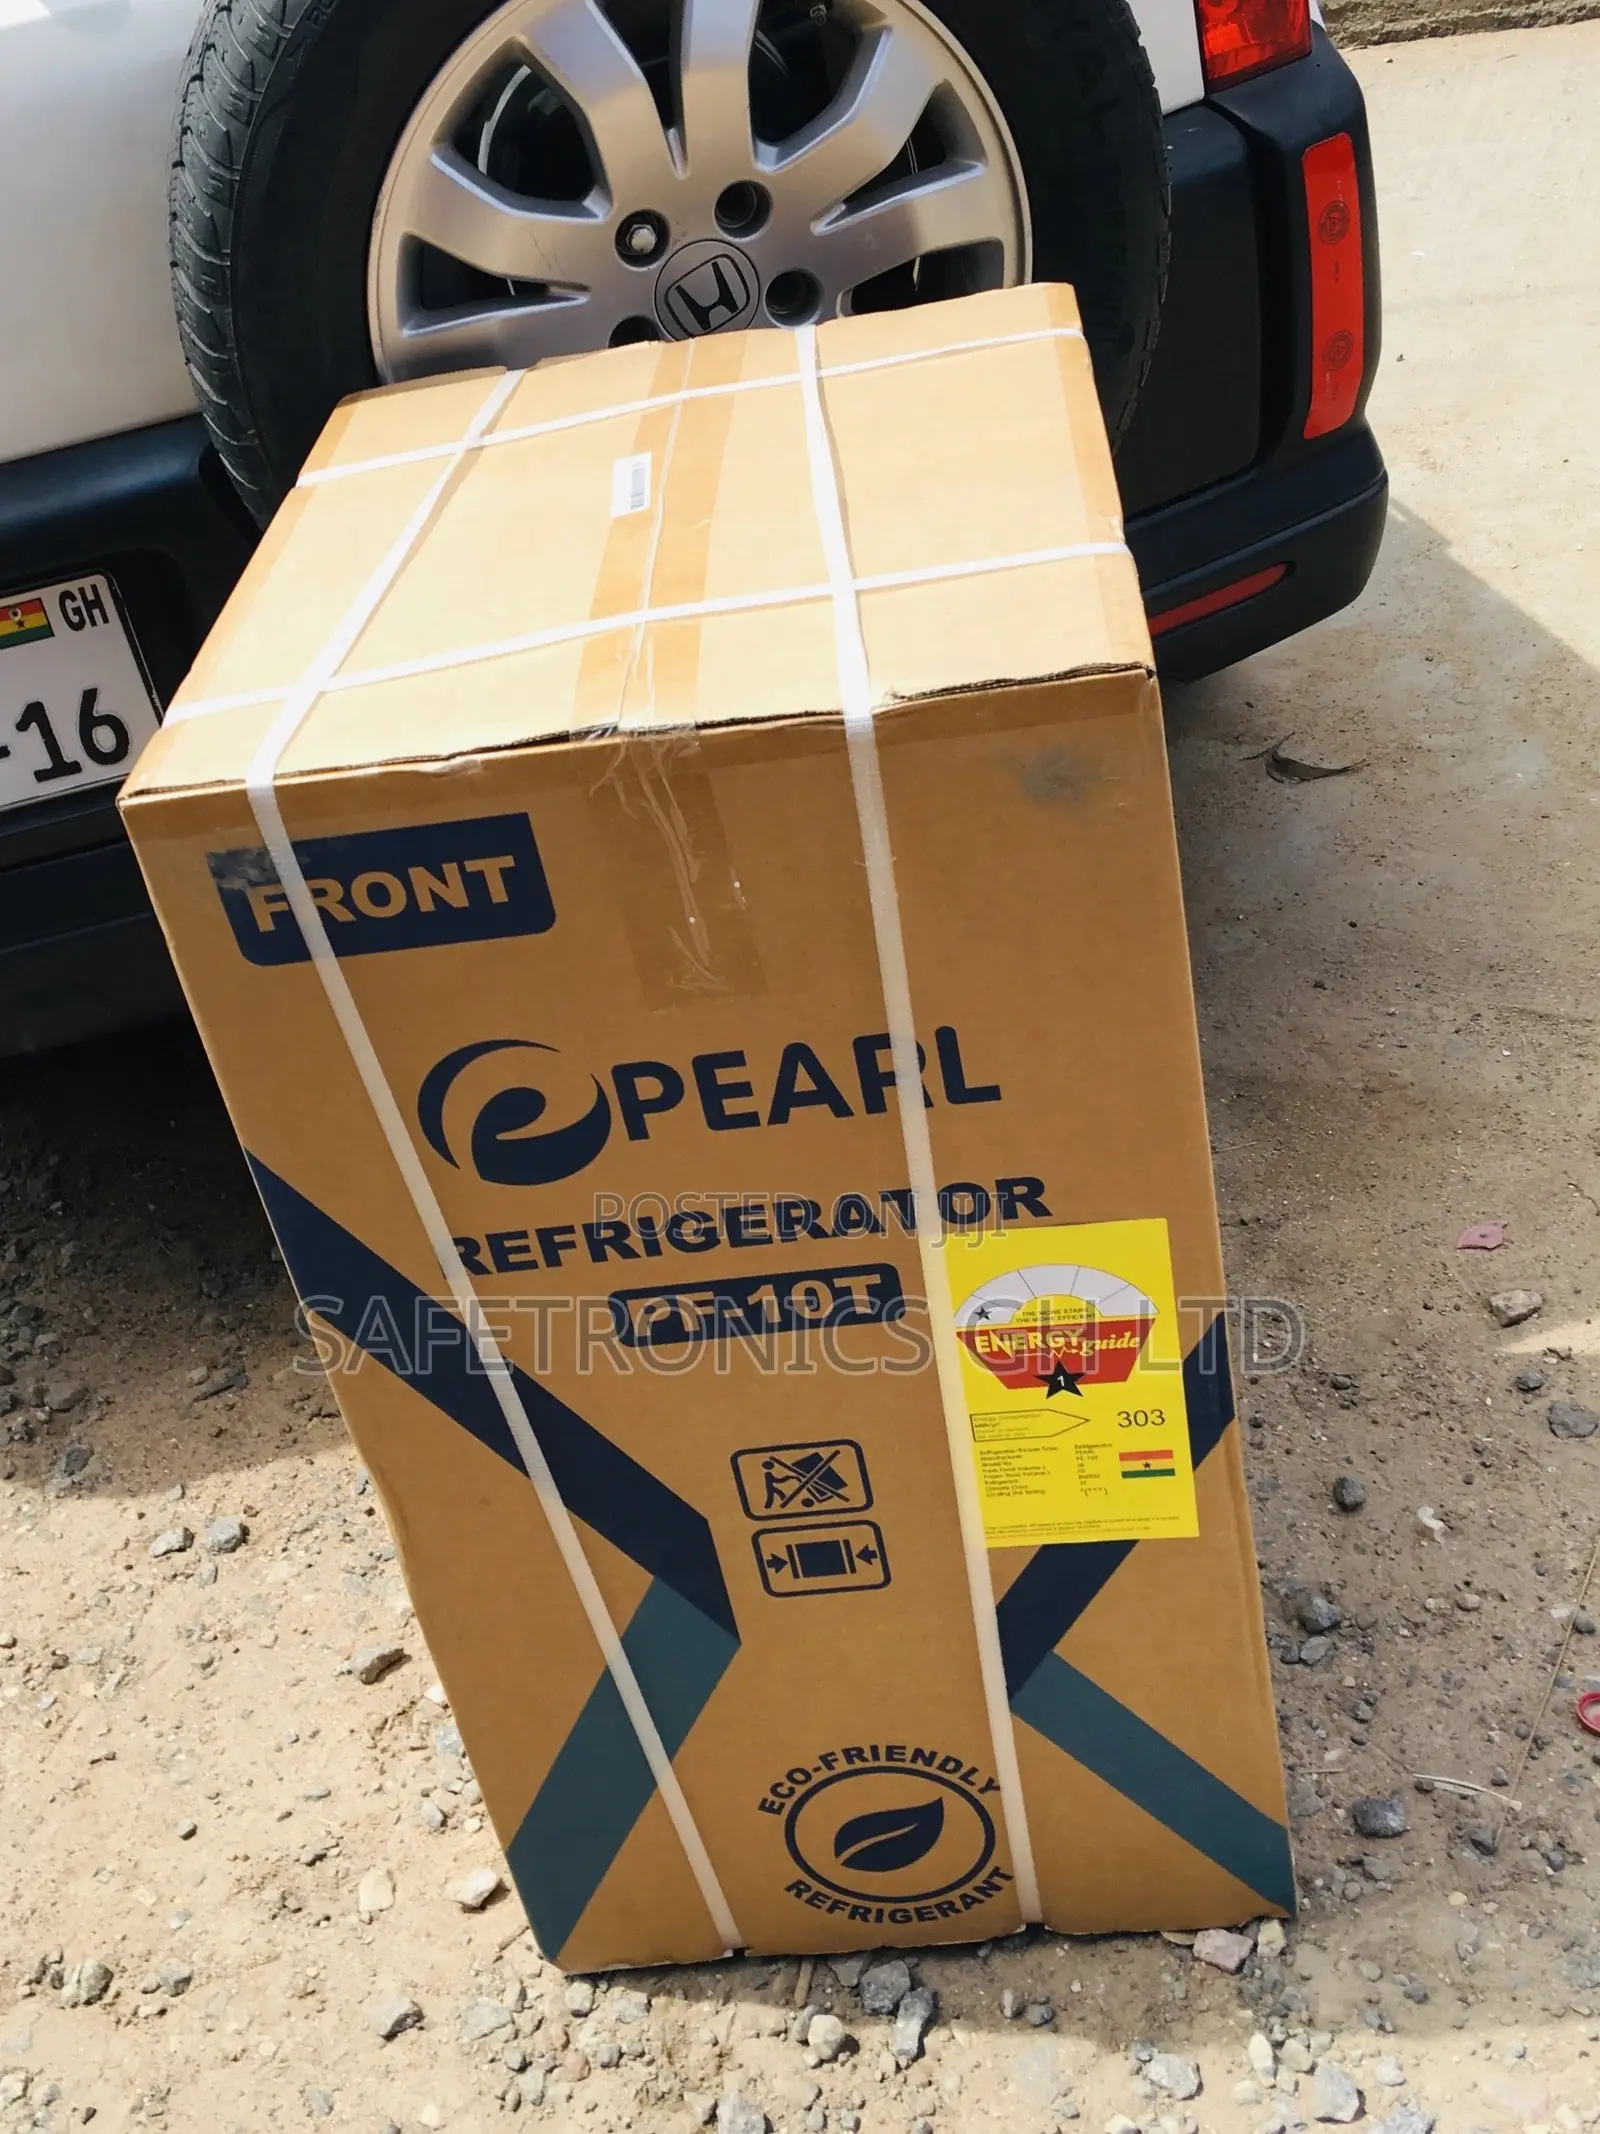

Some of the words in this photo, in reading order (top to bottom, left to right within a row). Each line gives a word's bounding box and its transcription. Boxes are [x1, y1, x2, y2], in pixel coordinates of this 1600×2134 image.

[58, 583, 110, 632] GH
[245, 854, 516, 933] FRONT
[610, 1025, 1002, 1142] PEARL
[440, 1176, 1054, 1280] REFRIGERATOR
[625, 1273, 882, 1338] PF-10T
[974, 1327, 1085, 1358] ENERGY
[1079, 1330, 1141, 1357] guide
[1056, 1375, 1066, 1388] 1
[1116, 1408, 1166, 1429] 303
[758, 1744, 1001, 1816] ECO-FRIENDLY
[784, 1865, 1015, 1925] REFRIGERANT
